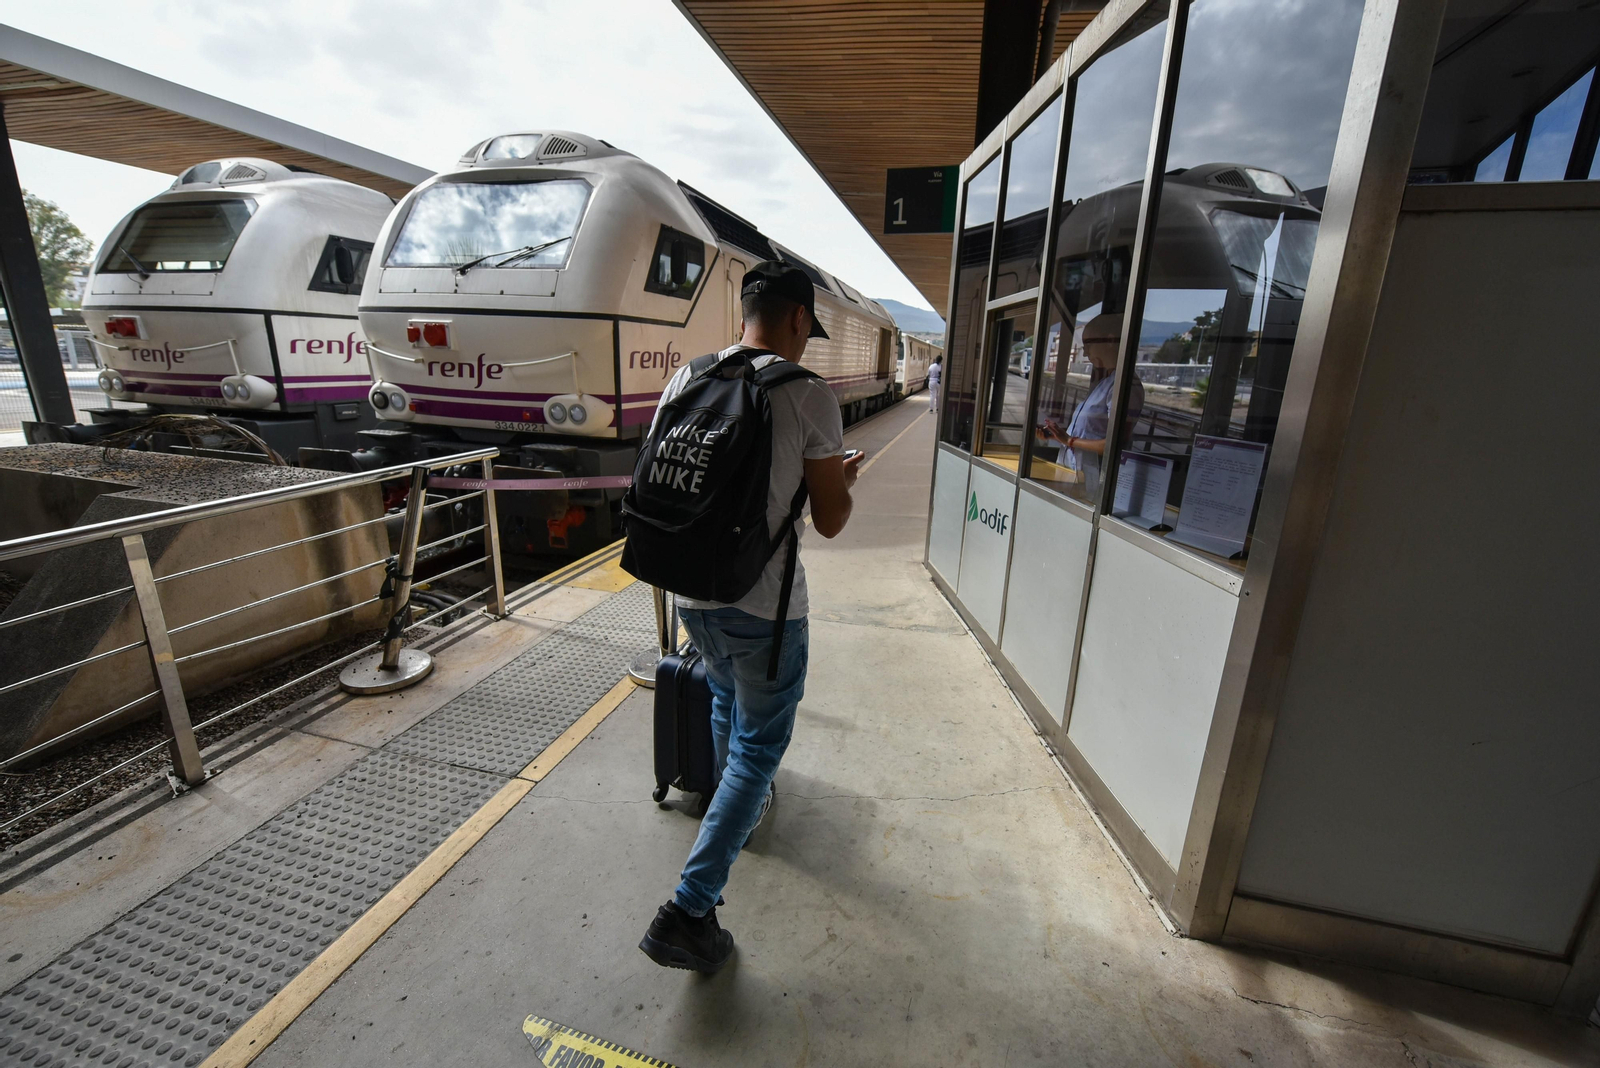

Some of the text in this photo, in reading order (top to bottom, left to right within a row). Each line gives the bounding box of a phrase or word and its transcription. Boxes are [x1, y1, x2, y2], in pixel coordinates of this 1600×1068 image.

[893, 197, 907, 225] 1
[132, 341, 184, 371] renfe
[290, 331, 366, 364] renfe
[628, 340, 681, 380] renfe
[427, 352, 504, 389] renfe
[494, 420, 545, 432] 334.022.1
[665, 424, 720, 445] NIKE
[656, 440, 712, 468] NIKE
[462, 480, 488, 489] renfe
[563, 478, 589, 489] renfe
[648, 461, 705, 493] NIKE
[980, 507, 1009, 536] adif
